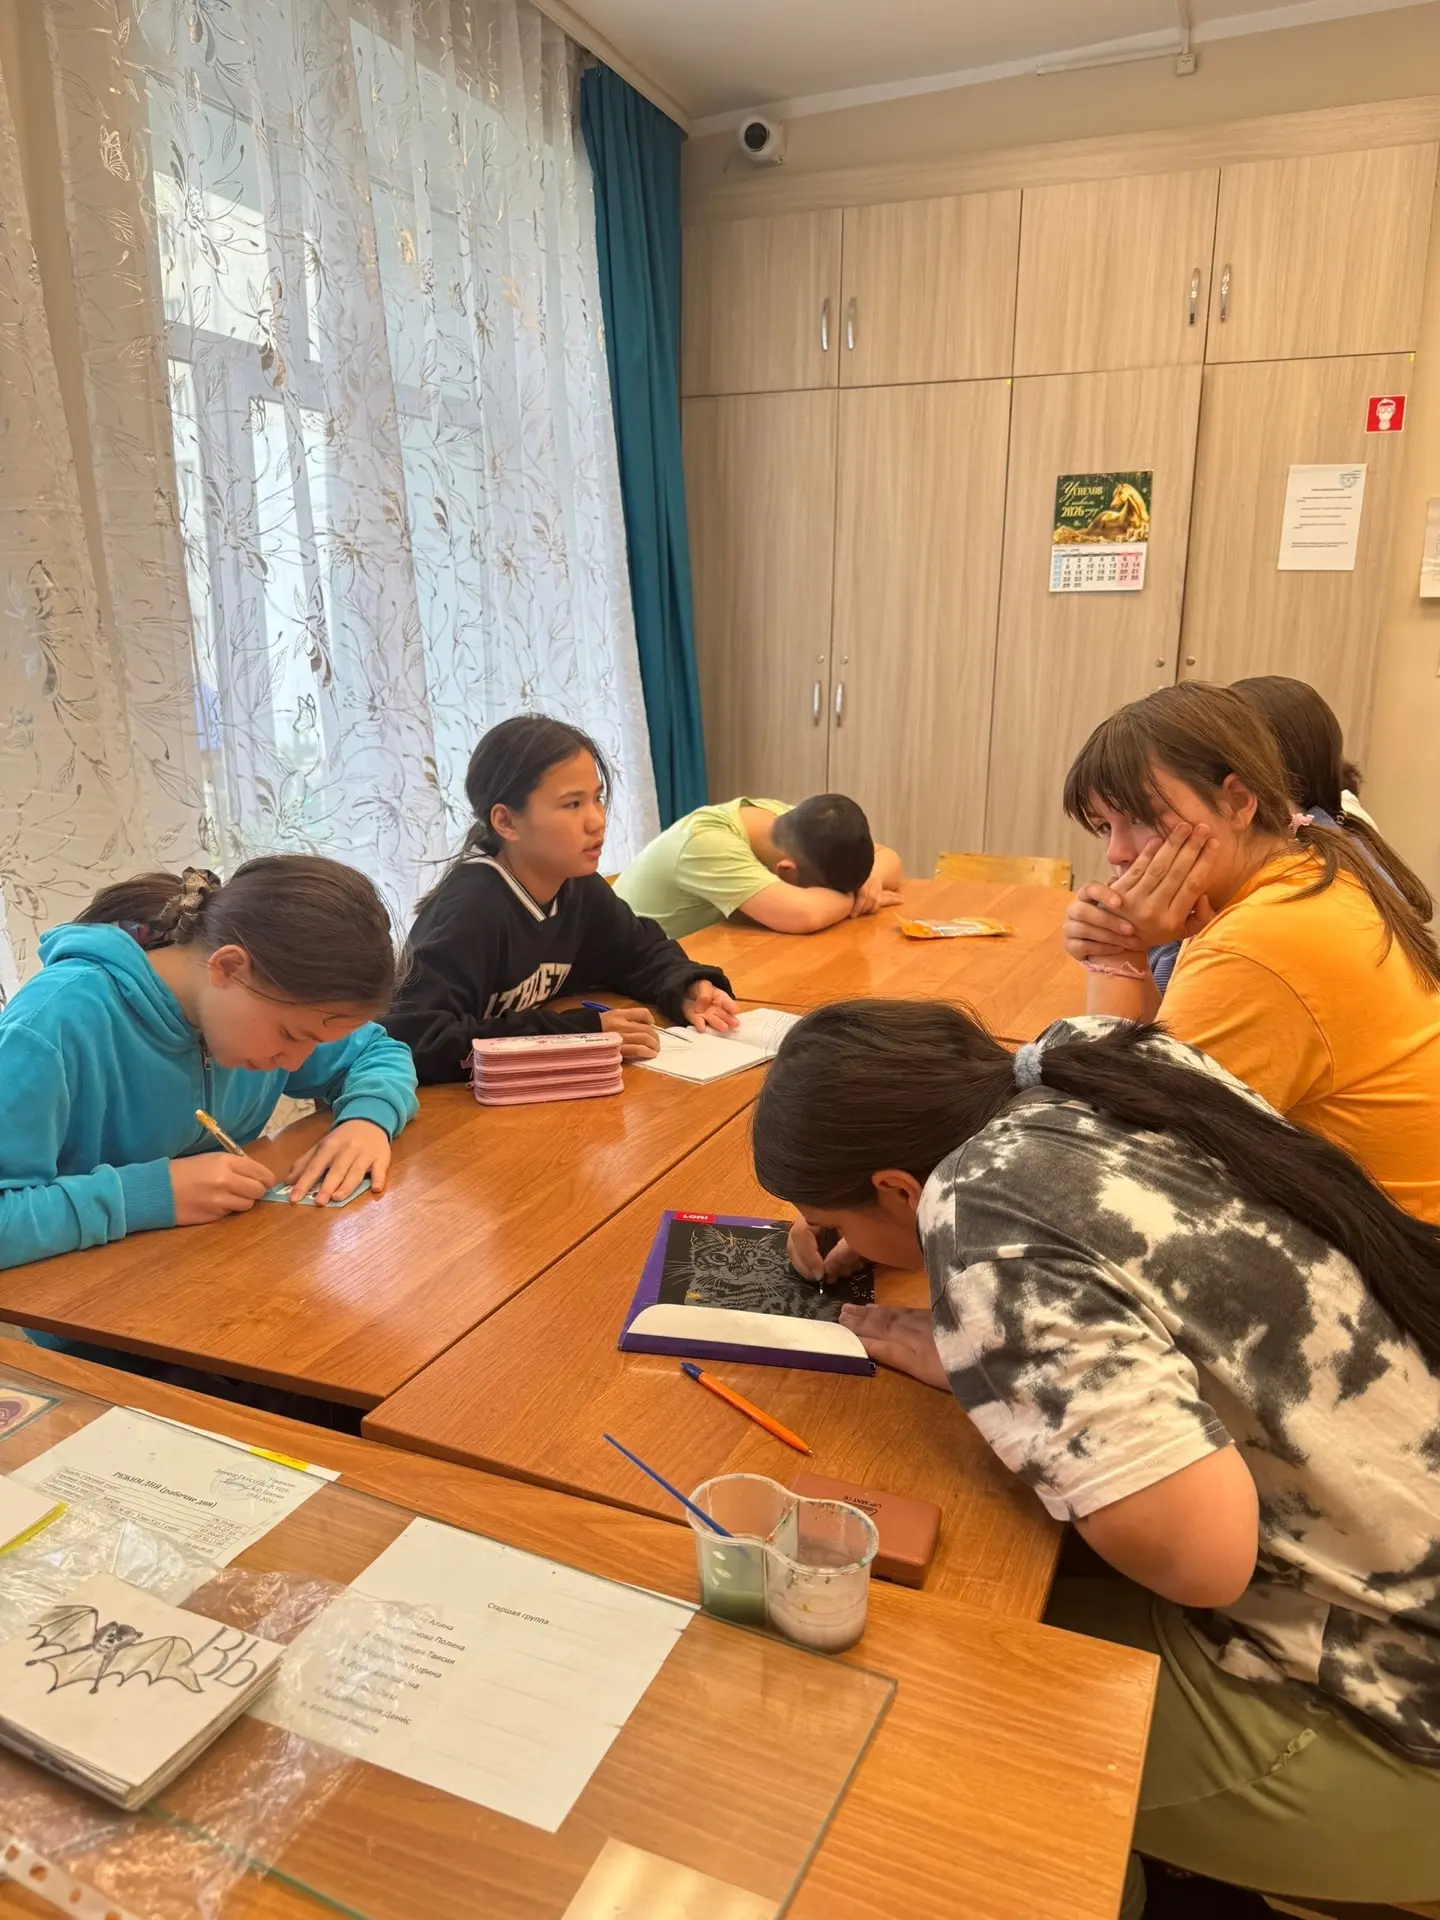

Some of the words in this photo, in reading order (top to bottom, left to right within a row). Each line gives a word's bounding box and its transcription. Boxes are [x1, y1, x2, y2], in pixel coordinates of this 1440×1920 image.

[1061, 506, 1085, 518] 2026
[113, 1471, 144, 1485] РЕЖИМ
[142, 1479, 162, 1490] ДНЯ
[159, 1486, 197, 1503] (рабочие
[195, 1498, 218, 1508] дни)
[487, 1602, 521, 1617] Старшая
[521, 1613, 549, 1625] группа
[429, 1619, 454, 1631] Алина
[434, 1636, 466, 1651] Полина
[428, 1651, 456, 1665] Таисия
[408, 1661, 443, 1679] Марина
